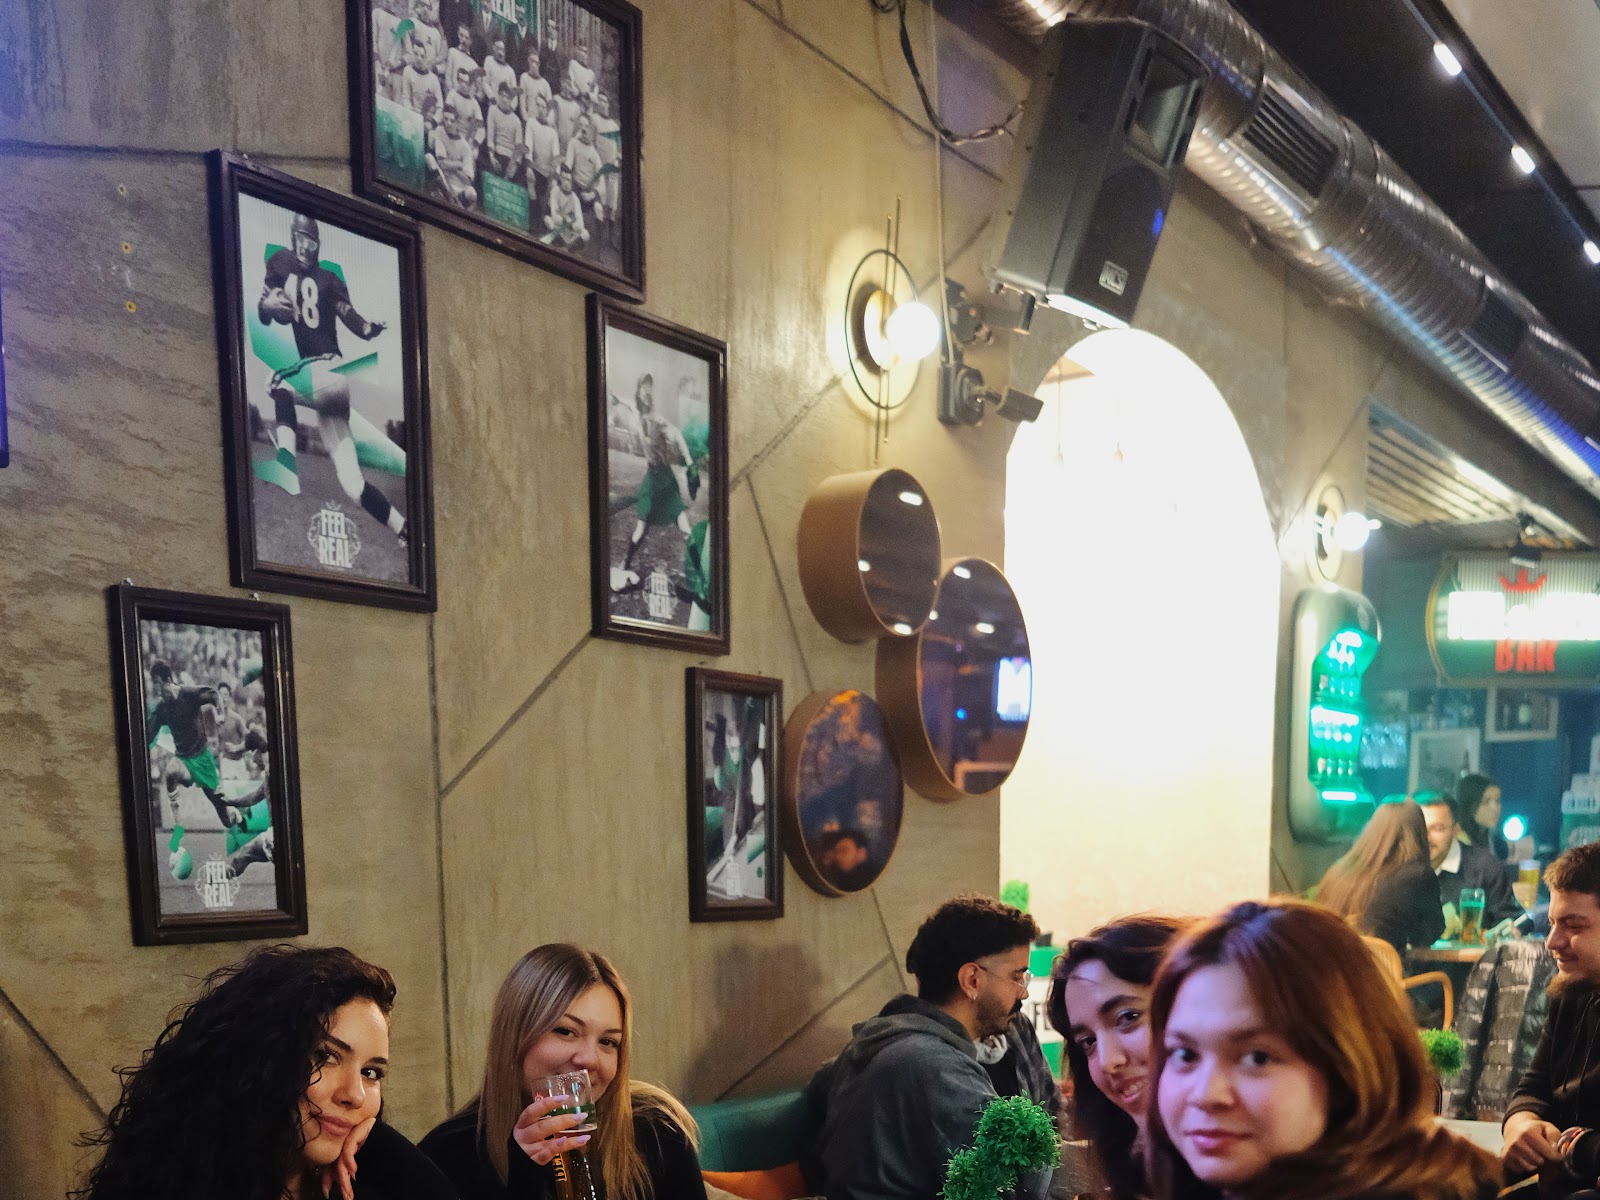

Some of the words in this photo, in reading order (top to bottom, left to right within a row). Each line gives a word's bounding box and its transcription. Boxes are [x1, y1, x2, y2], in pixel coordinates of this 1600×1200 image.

[321, 508, 348, 540] FEEL
[319, 534, 353, 568] REAL
[651, 571, 670, 596] FEEL
[649, 592, 673, 619] REAL
[1495, 639, 1558, 673] BAR
[206, 861, 229, 885] FEEL
[204, 883, 234, 908] REAL
